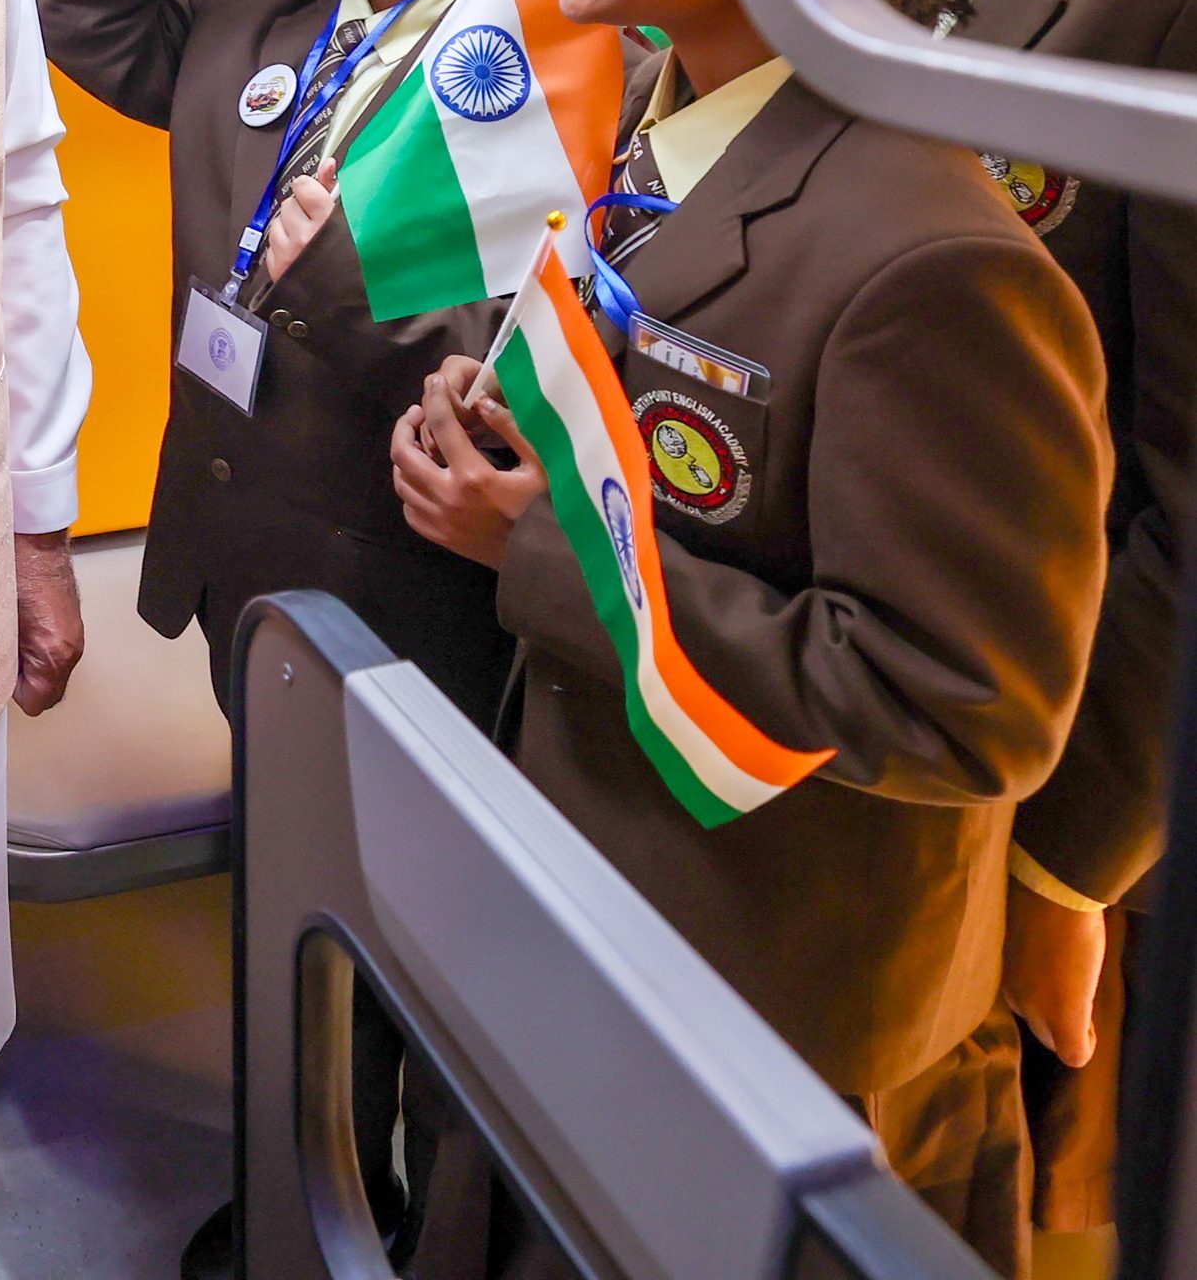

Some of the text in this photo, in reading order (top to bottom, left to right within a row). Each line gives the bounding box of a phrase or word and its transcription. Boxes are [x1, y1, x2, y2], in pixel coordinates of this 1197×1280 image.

[305, 80, 324, 99] NPEA
[313, 107, 334, 126] NPEA
[301, 153, 321, 174] NPEA
